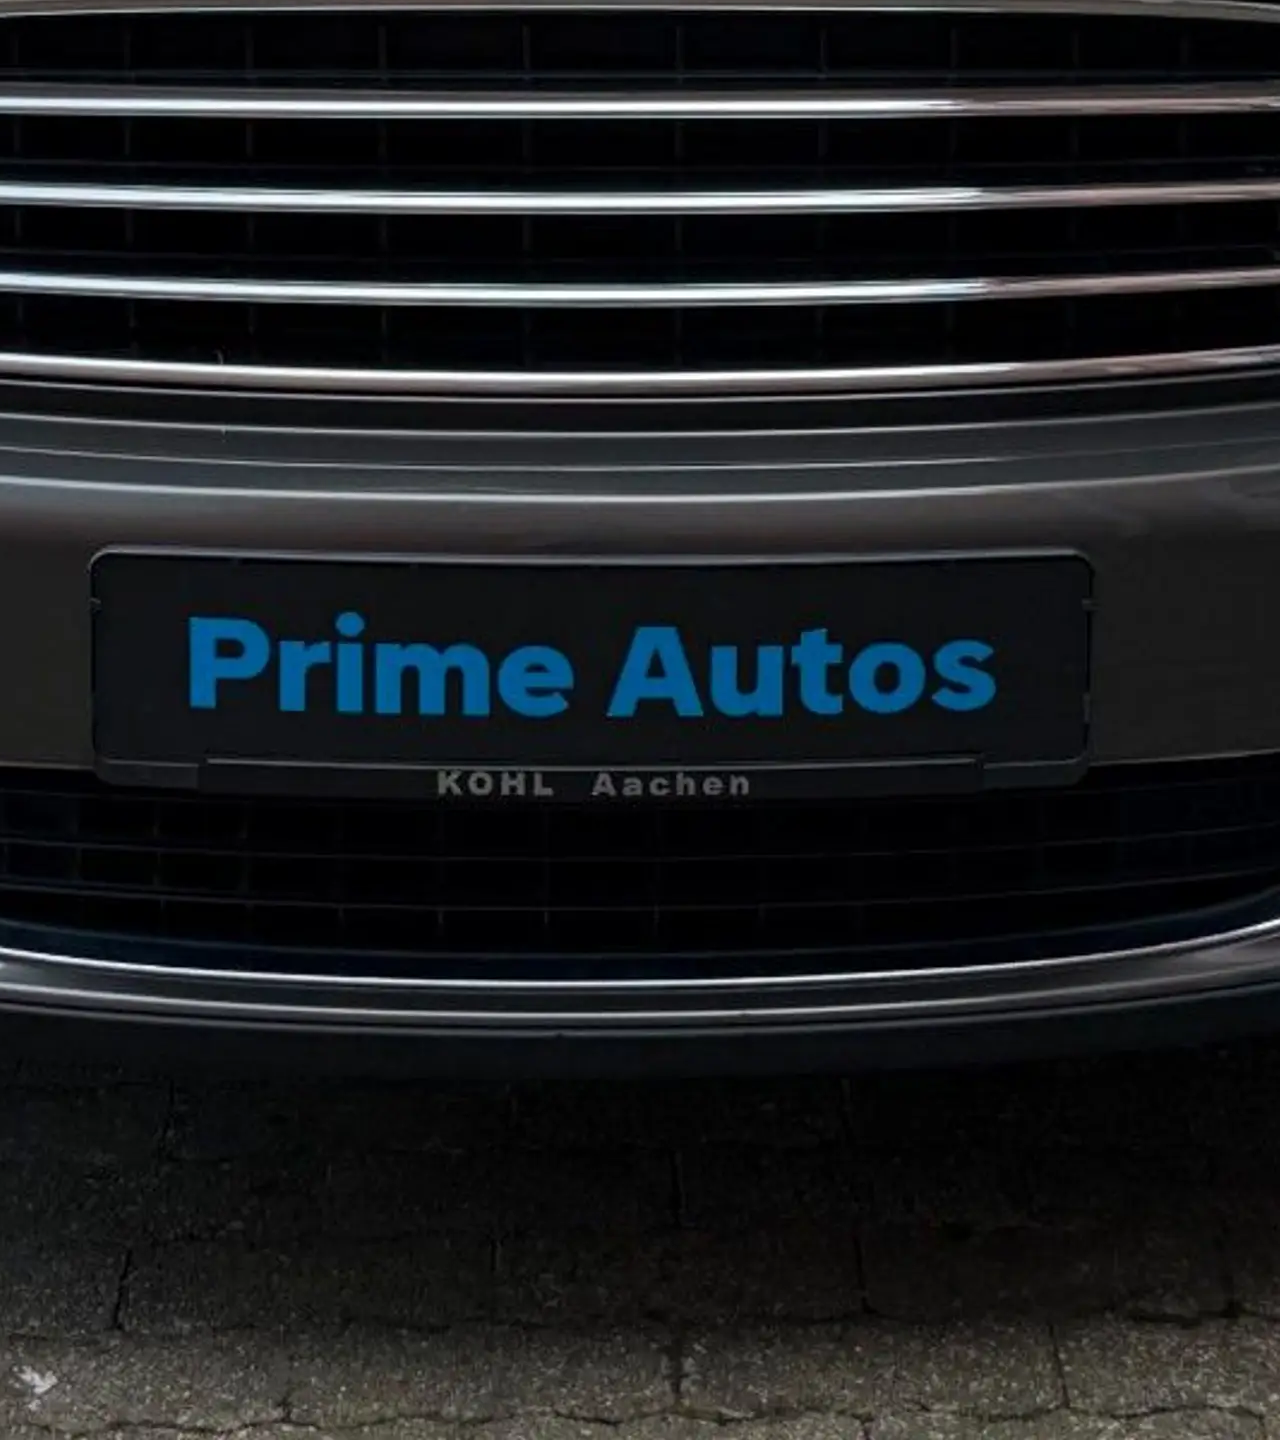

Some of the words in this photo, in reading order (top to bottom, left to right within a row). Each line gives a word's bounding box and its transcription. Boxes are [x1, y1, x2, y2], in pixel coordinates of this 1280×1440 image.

[188, 612, 575, 718] Prime
[607, 625, 997, 718] Autos
[437, 770, 554, 796] KOHL
[591, 771, 750, 796] Aachen
